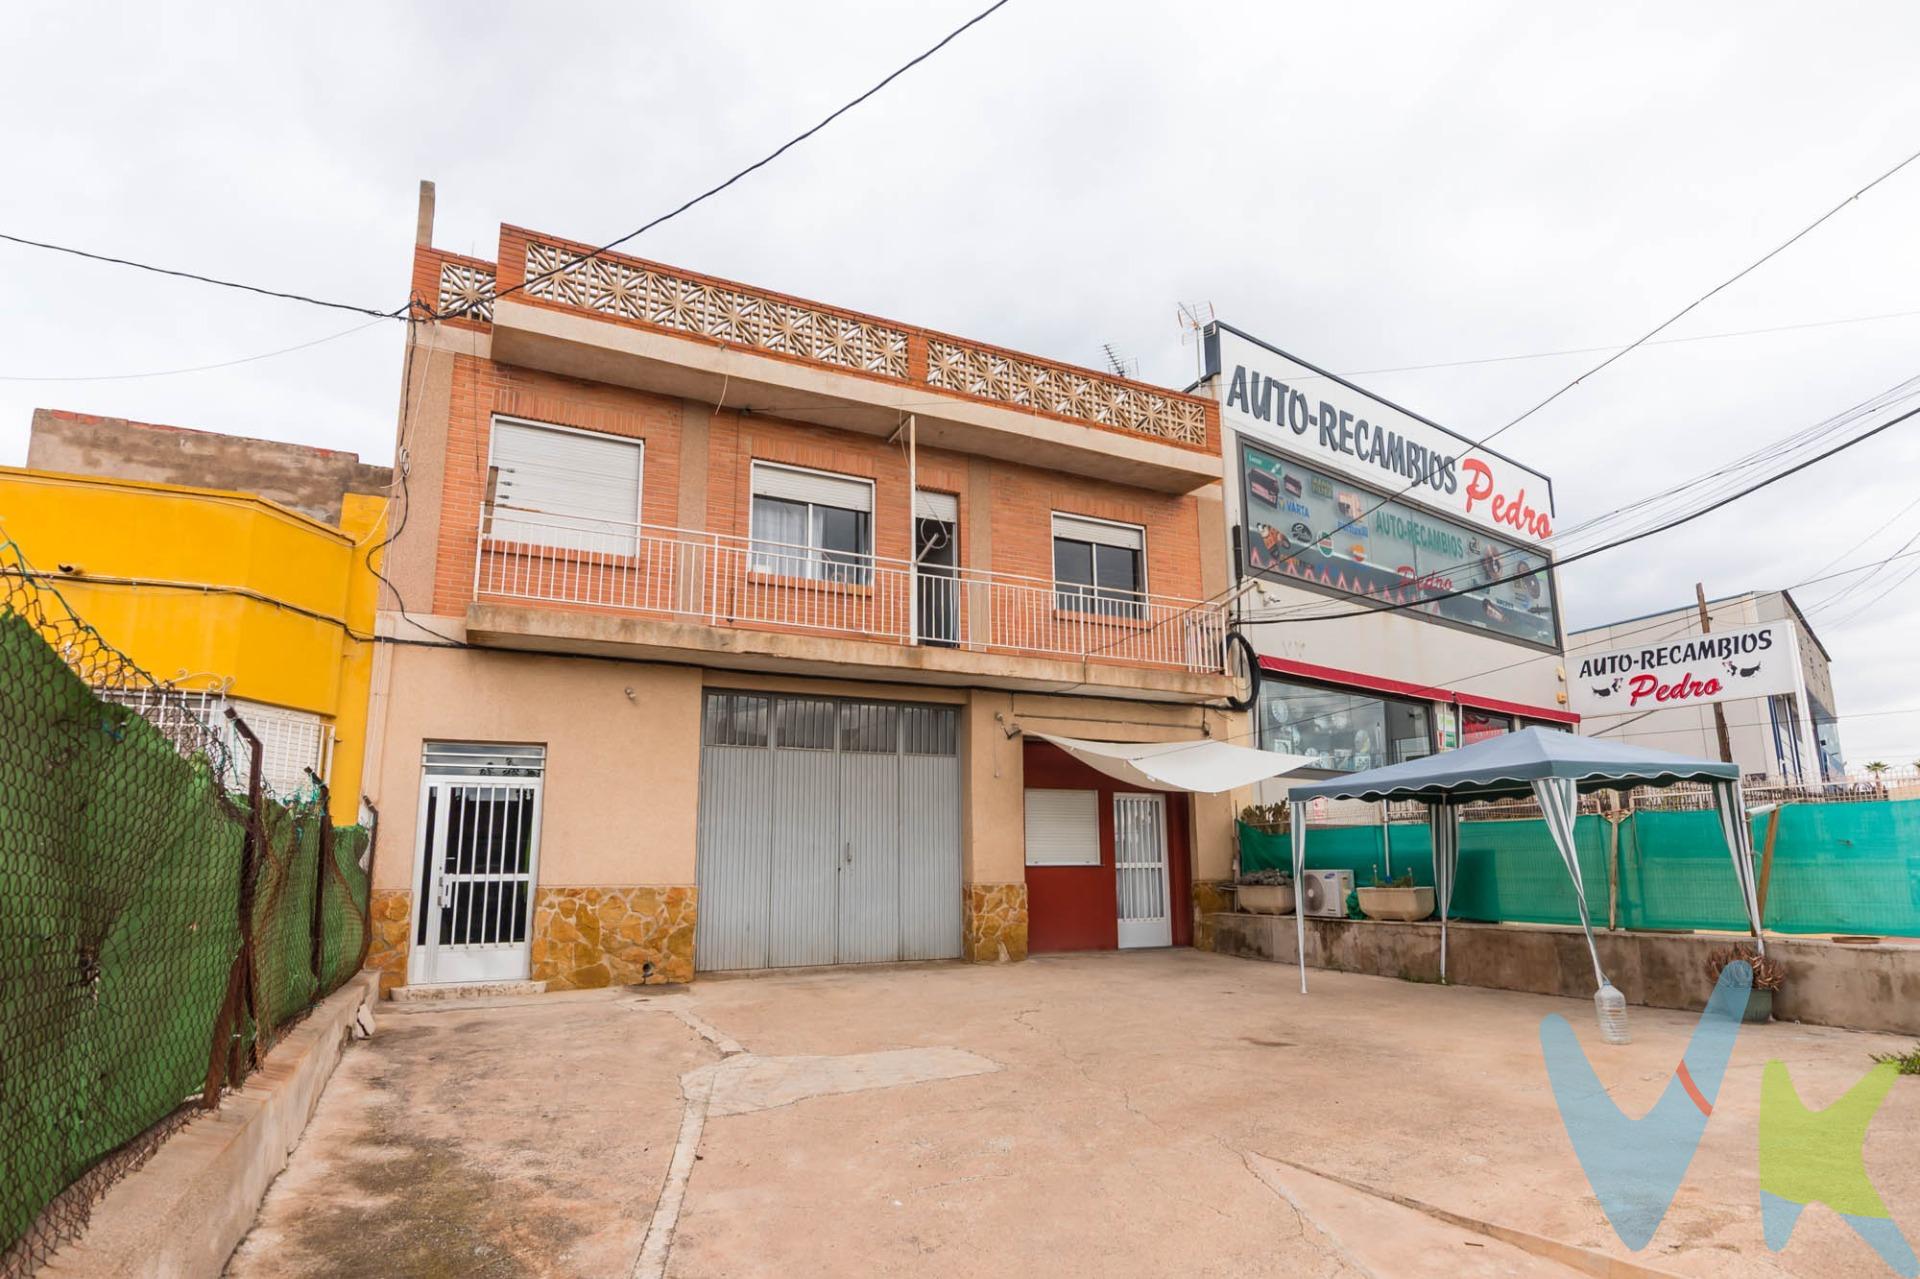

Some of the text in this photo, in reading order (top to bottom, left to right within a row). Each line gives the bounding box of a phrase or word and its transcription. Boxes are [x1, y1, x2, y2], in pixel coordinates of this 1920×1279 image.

[1227, 365, 1553, 539] AUTO-RECAMBIOS Pedro
[1376, 510, 1463, 558] AUTO-RECAMBIOS
[1396, 565, 1453, 592] Pedro
[1579, 629, 1773, 679] AUTO-RECAMBIOS
[1628, 672, 1723, 706] Pedro
